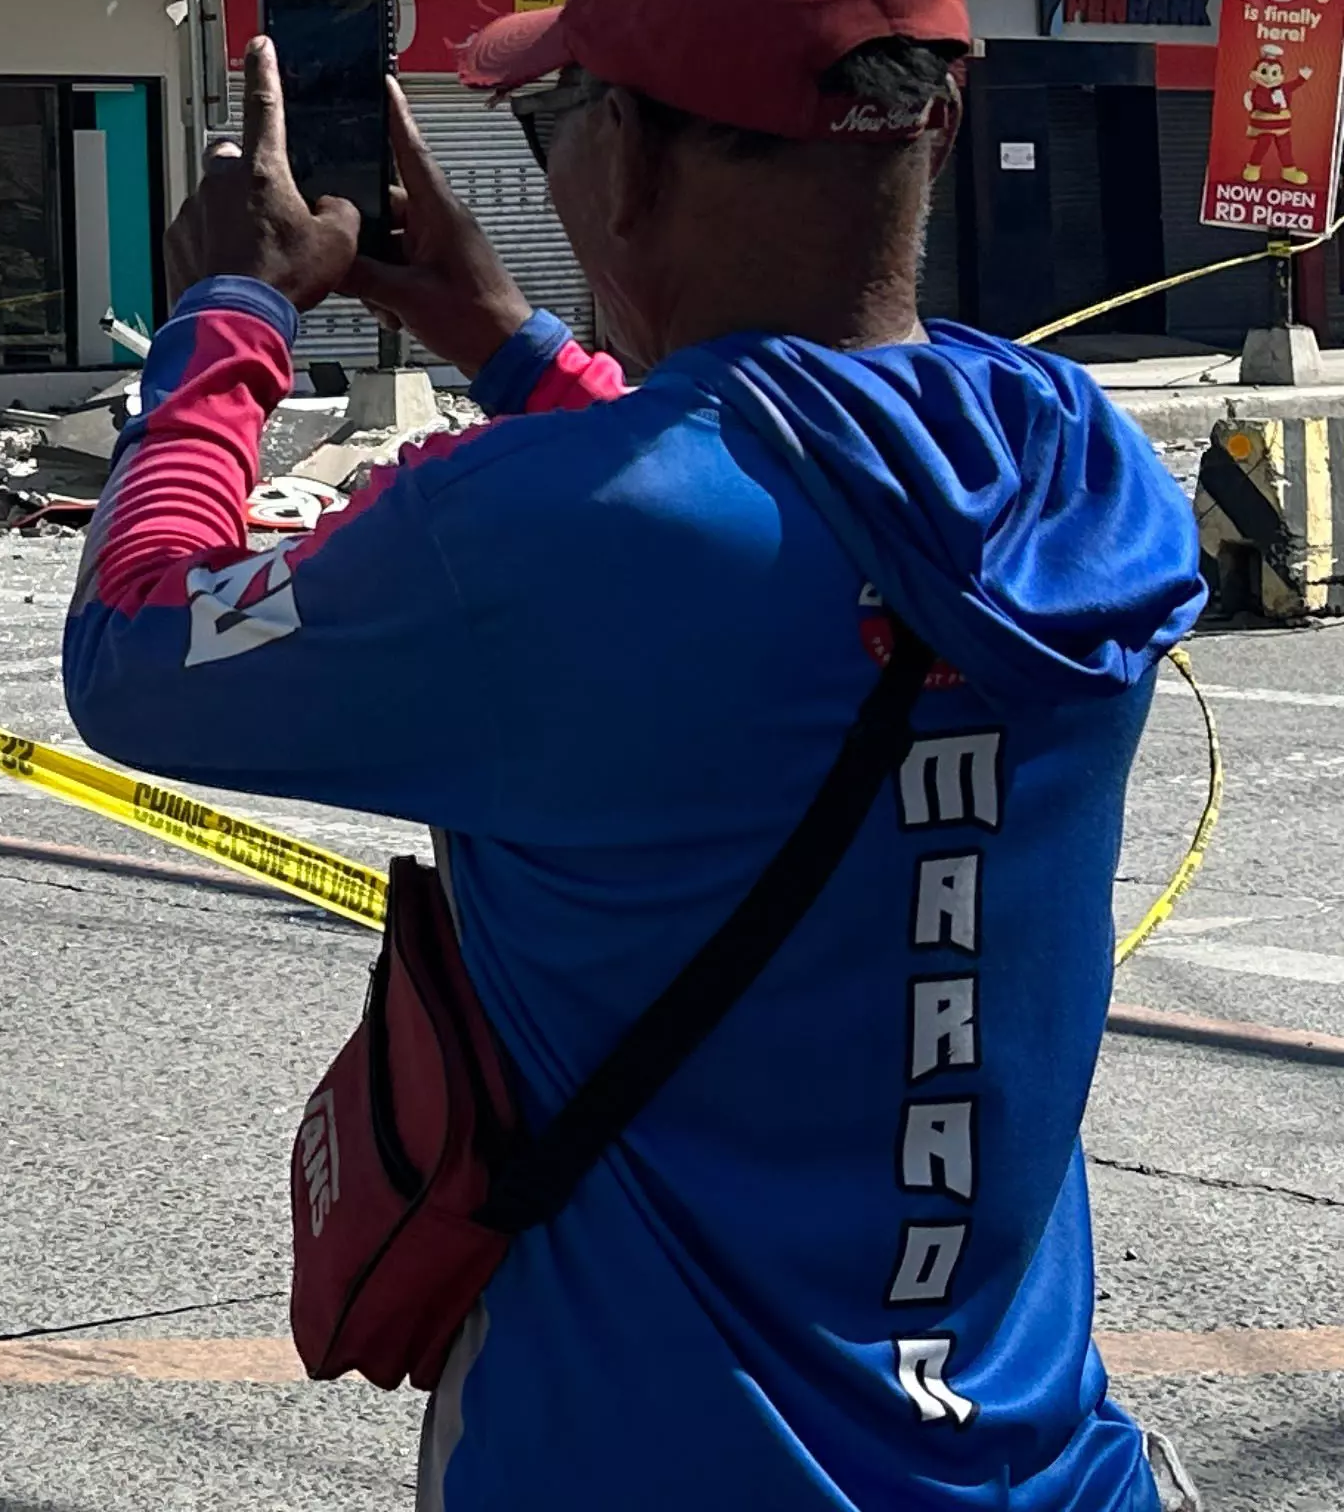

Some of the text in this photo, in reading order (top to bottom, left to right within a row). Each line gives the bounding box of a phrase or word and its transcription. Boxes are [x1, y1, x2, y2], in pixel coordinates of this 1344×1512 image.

[1244, 3, 1321, 30] is finally
[1257, 21, 1306, 42] here!
[1216, 185, 1316, 208] NOW OPEN
[1215, 203, 1314, 230] RD Plaza
